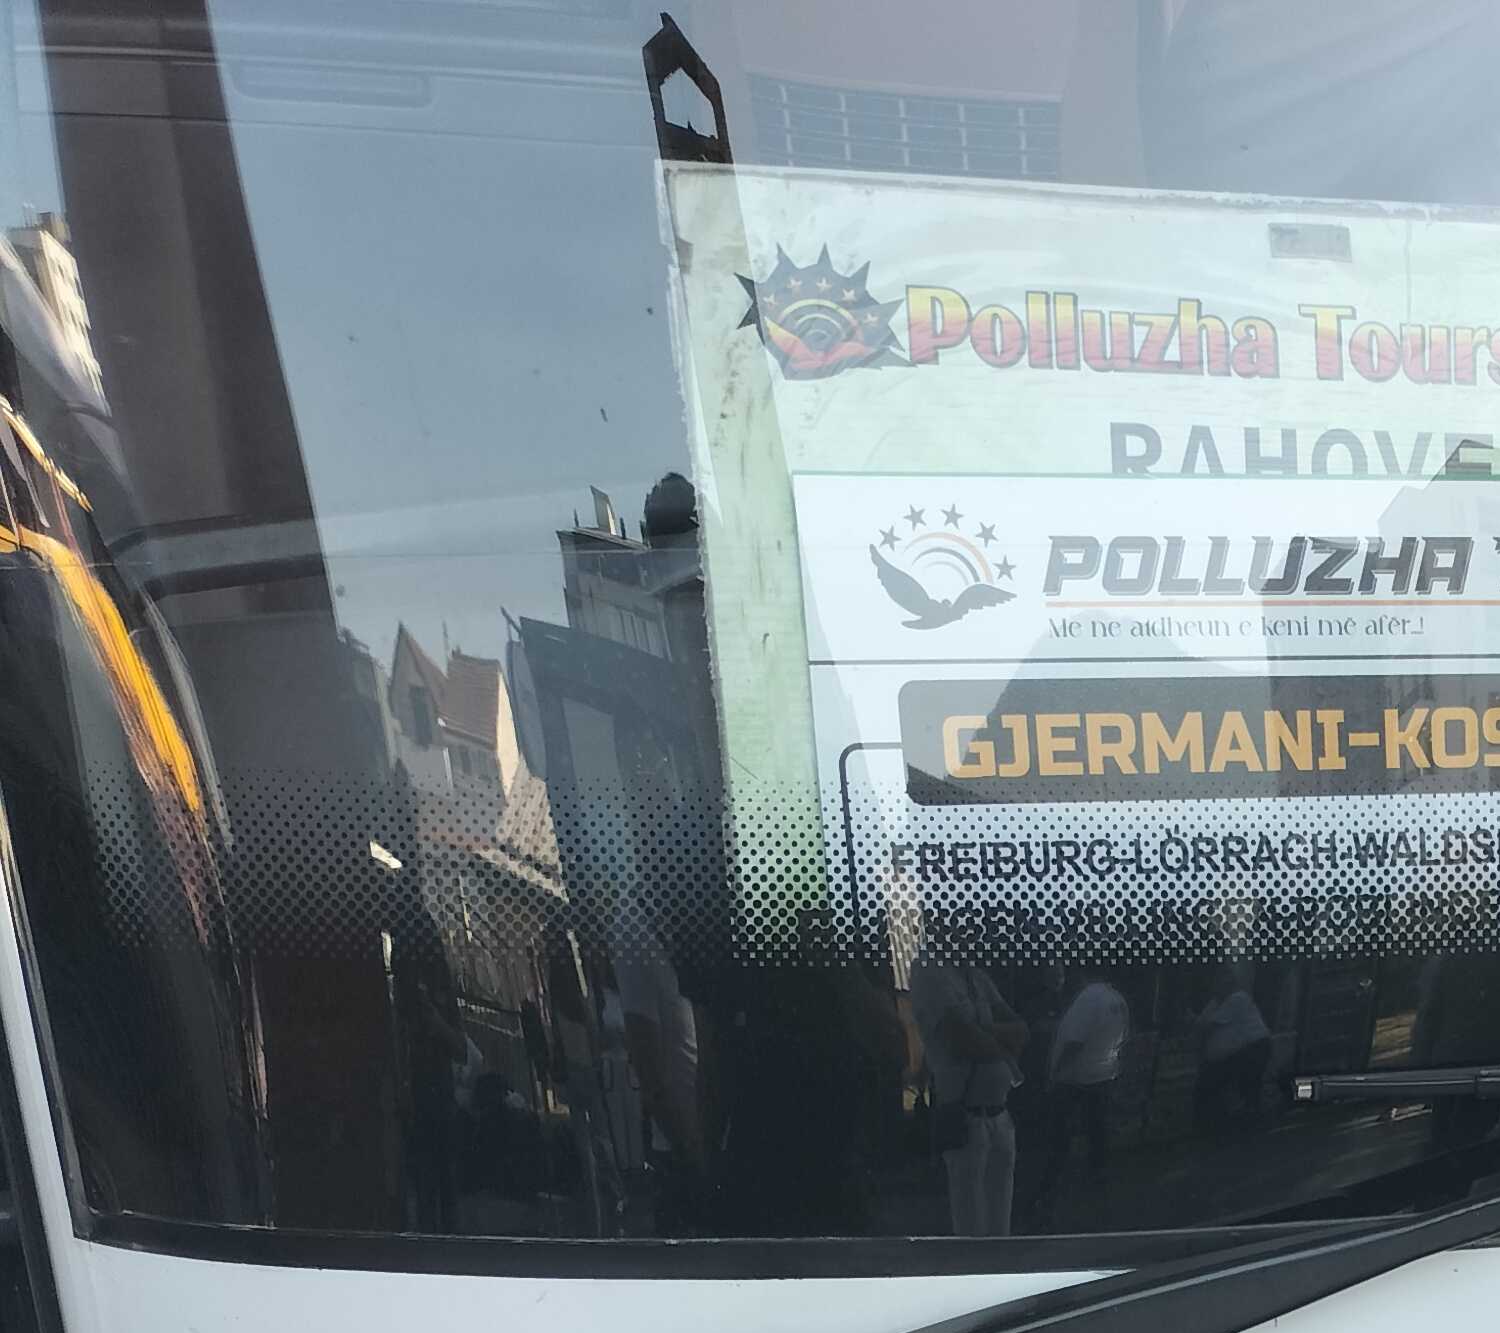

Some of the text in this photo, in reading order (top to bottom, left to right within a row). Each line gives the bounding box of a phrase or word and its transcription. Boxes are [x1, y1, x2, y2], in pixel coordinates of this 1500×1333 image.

[905, 283, 1279, 379] Polluzha
[1042, 535, 1475, 596] POLLUZHA
[1049, 618, 1082, 638] Me
[1261, 615, 1308, 636] keni
